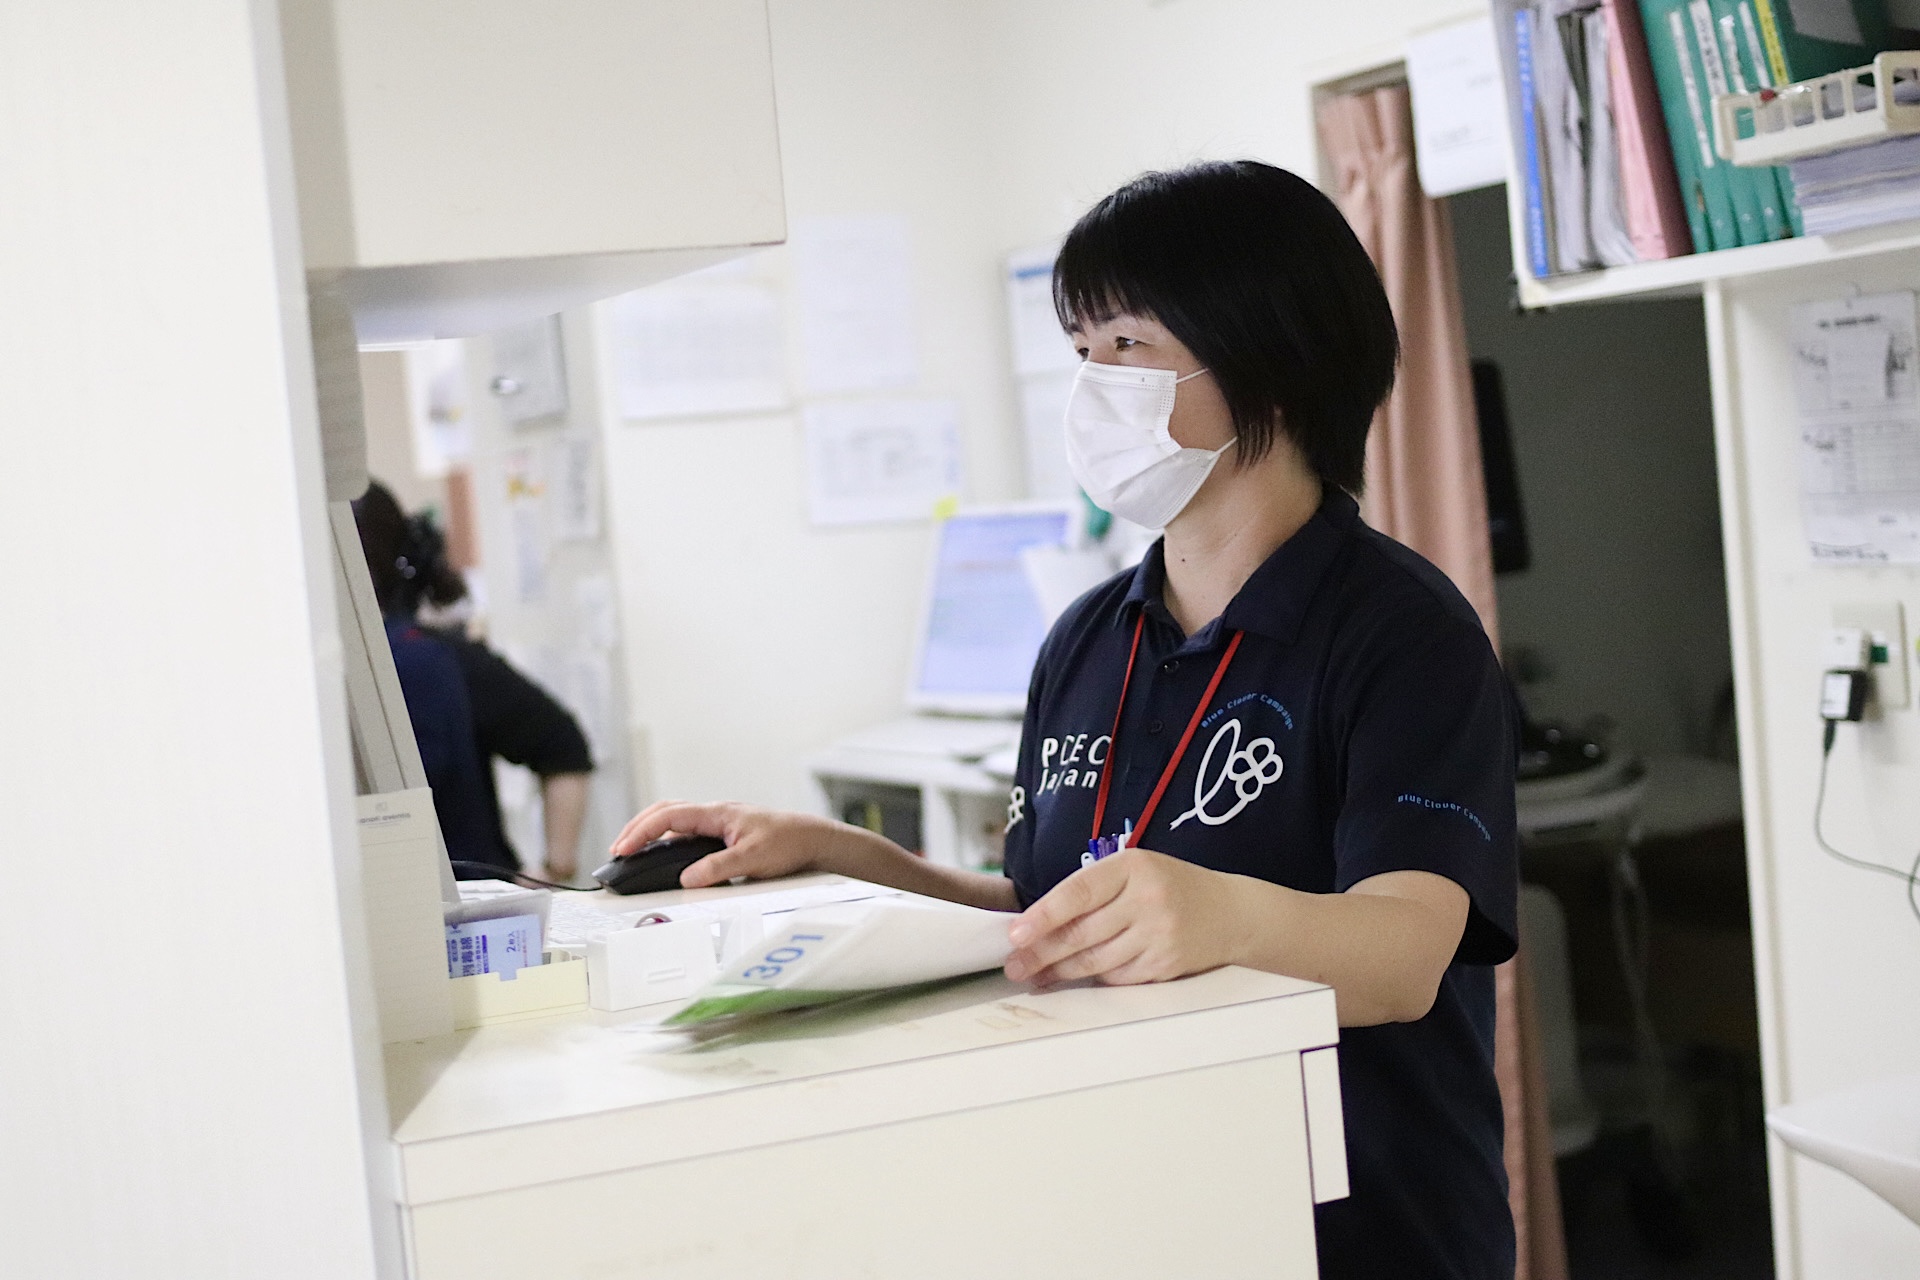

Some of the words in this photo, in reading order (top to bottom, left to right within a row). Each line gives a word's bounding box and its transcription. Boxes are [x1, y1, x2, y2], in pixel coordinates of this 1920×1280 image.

[1201, 708, 1224, 728] Blue
[1227, 693, 1257, 709] Clover
[1260, 694, 1294, 730] Campaign
[1397, 794, 1421, 804] Blue
[1424, 799, 1461, 812] Clover
[743, 934, 824, 979] 301
